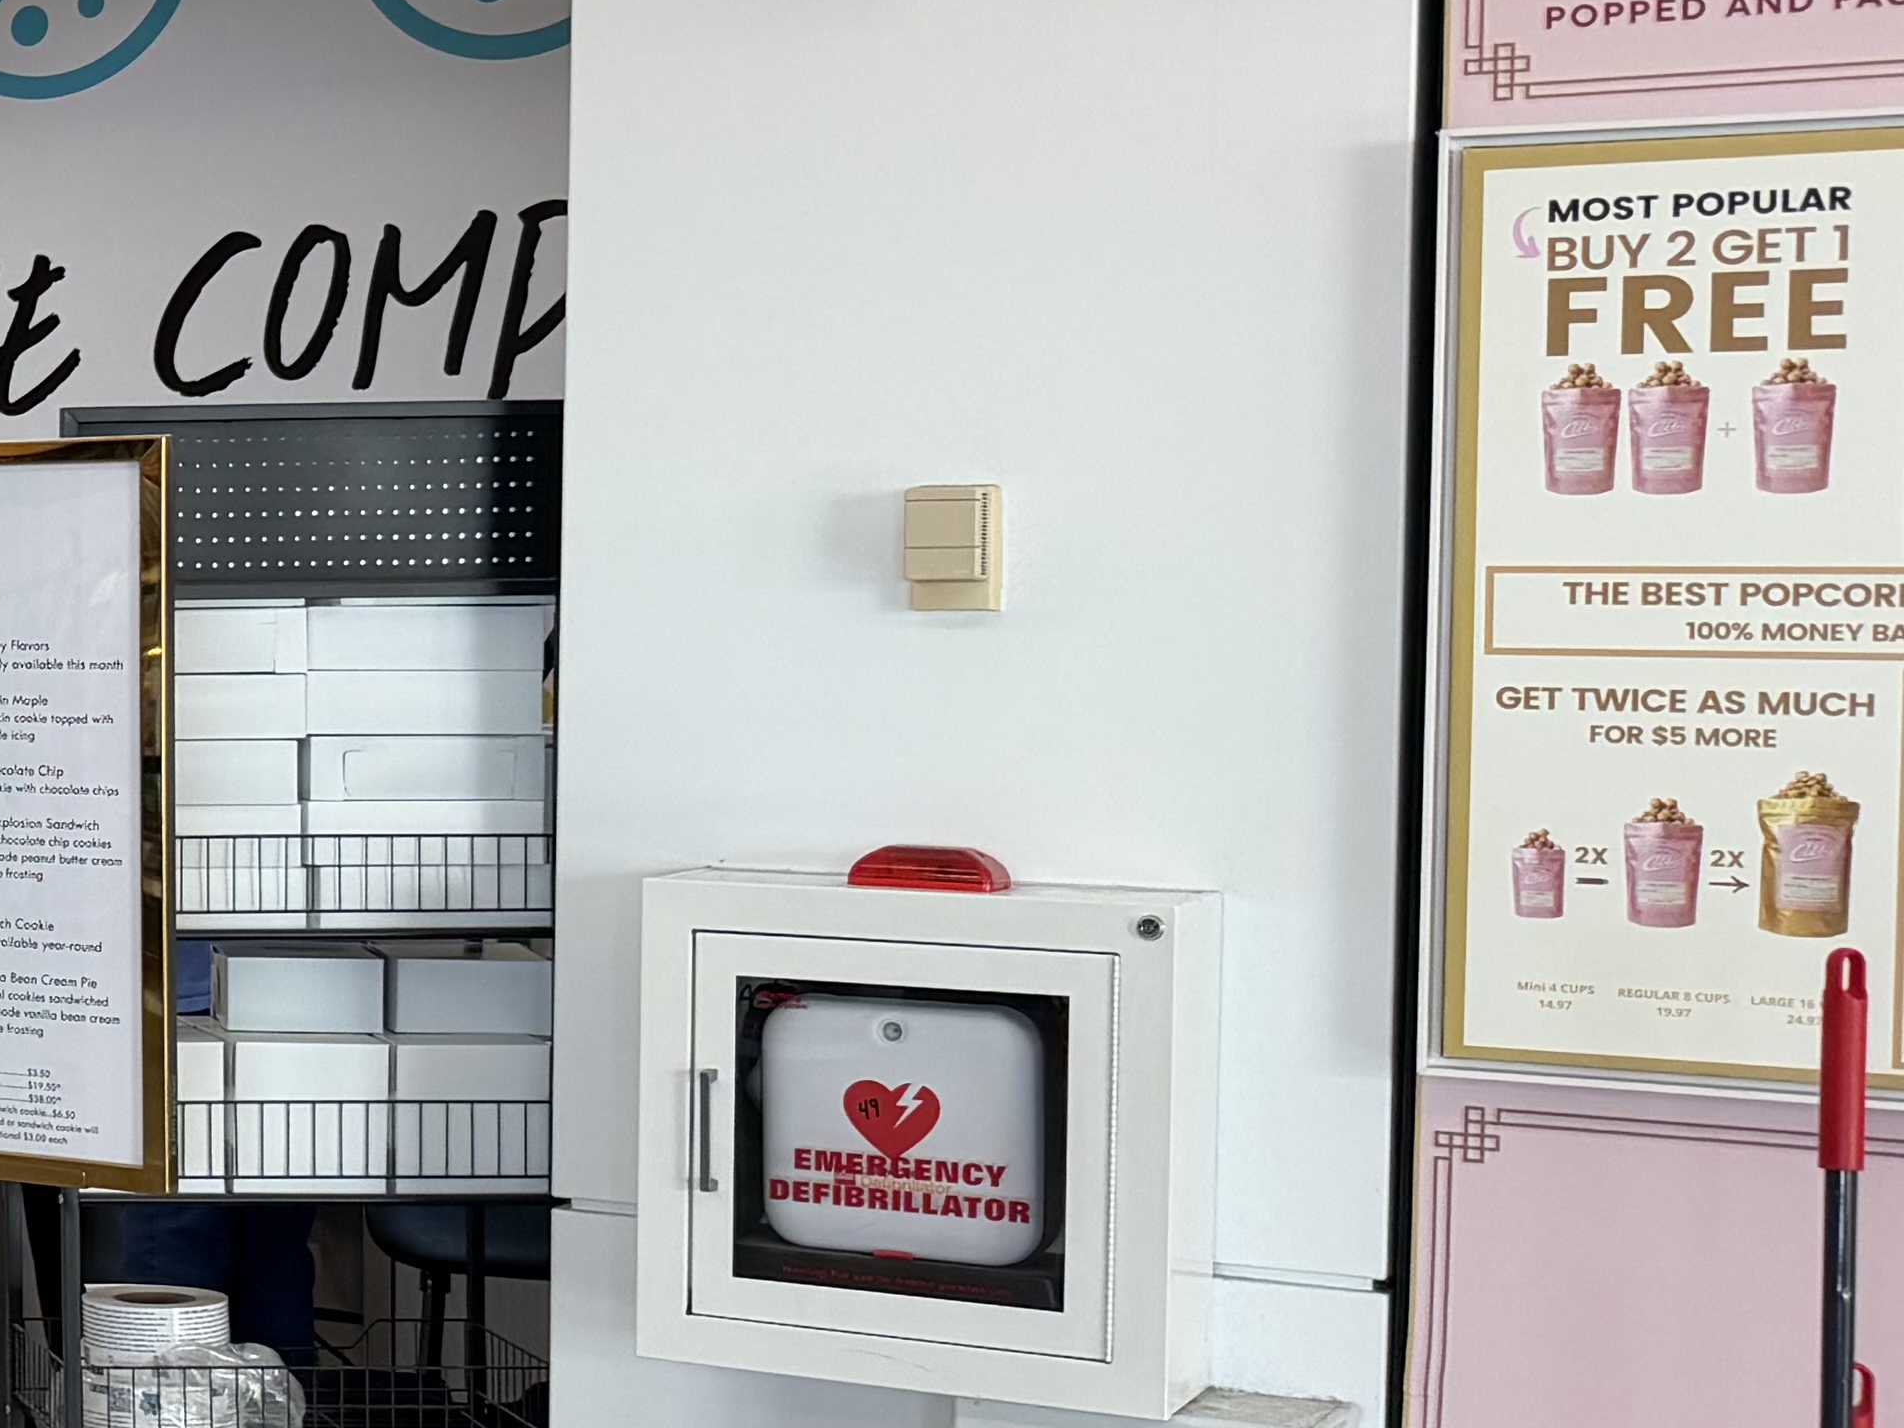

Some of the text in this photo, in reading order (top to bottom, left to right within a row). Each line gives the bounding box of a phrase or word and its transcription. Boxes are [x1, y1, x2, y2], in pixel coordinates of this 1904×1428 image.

[1548, 186, 1852, 223] MOST POPULAR
[1547, 224, 1849, 271] BUY 2 GET 1
[152, 200, 563, 400] COMP
[1546, 267, 1849, 356] FREE
[1563, 582, 1629, 606] THE
[1641, 582, 1729, 606] BEST
[1686, 622, 1753, 641] 100%
[1762, 623, 1864, 642] MONEY
[11, 641, 50, 651] Flavors
[12, 659, 64, 670] available
[67, 660, 85, 670] this
[89, 661, 124, 671] month
[12, 695, 48, 707] Maple
[1496, 686, 1875, 717] GET TWICE AS MUCH
[1589, 725, 1777, 748] FOR $5 MORE
[38, 765, 64, 779] Chip
[46, 818, 100, 830] Sandwich
[1574, 847, 1608, 864] 2X
[1710, 850, 1745, 868] 2X
[15, 918, 54, 931] Cookie
[42, 941, 102, 953] year-round
[11, 972, 37, 985] Bean
[41, 975, 77, 987] Cream
[81, 977, 97, 988] Pie
[1517, 981, 1595, 995] Mini 4 CUPS
[1618, 988, 1730, 1004] REGULAR 8 CUPS
[1750, 996, 1815, 1009] LARGE 16
[1539, 999, 1572, 1010] 14.97
[1657, 1007, 1692, 1018] 19.97
[858, 1098, 880, 1120] 49
[794, 1148, 1008, 1187] EMERGENCY
[769, 1179, 1030, 1223] DEFIBRILLATOR
